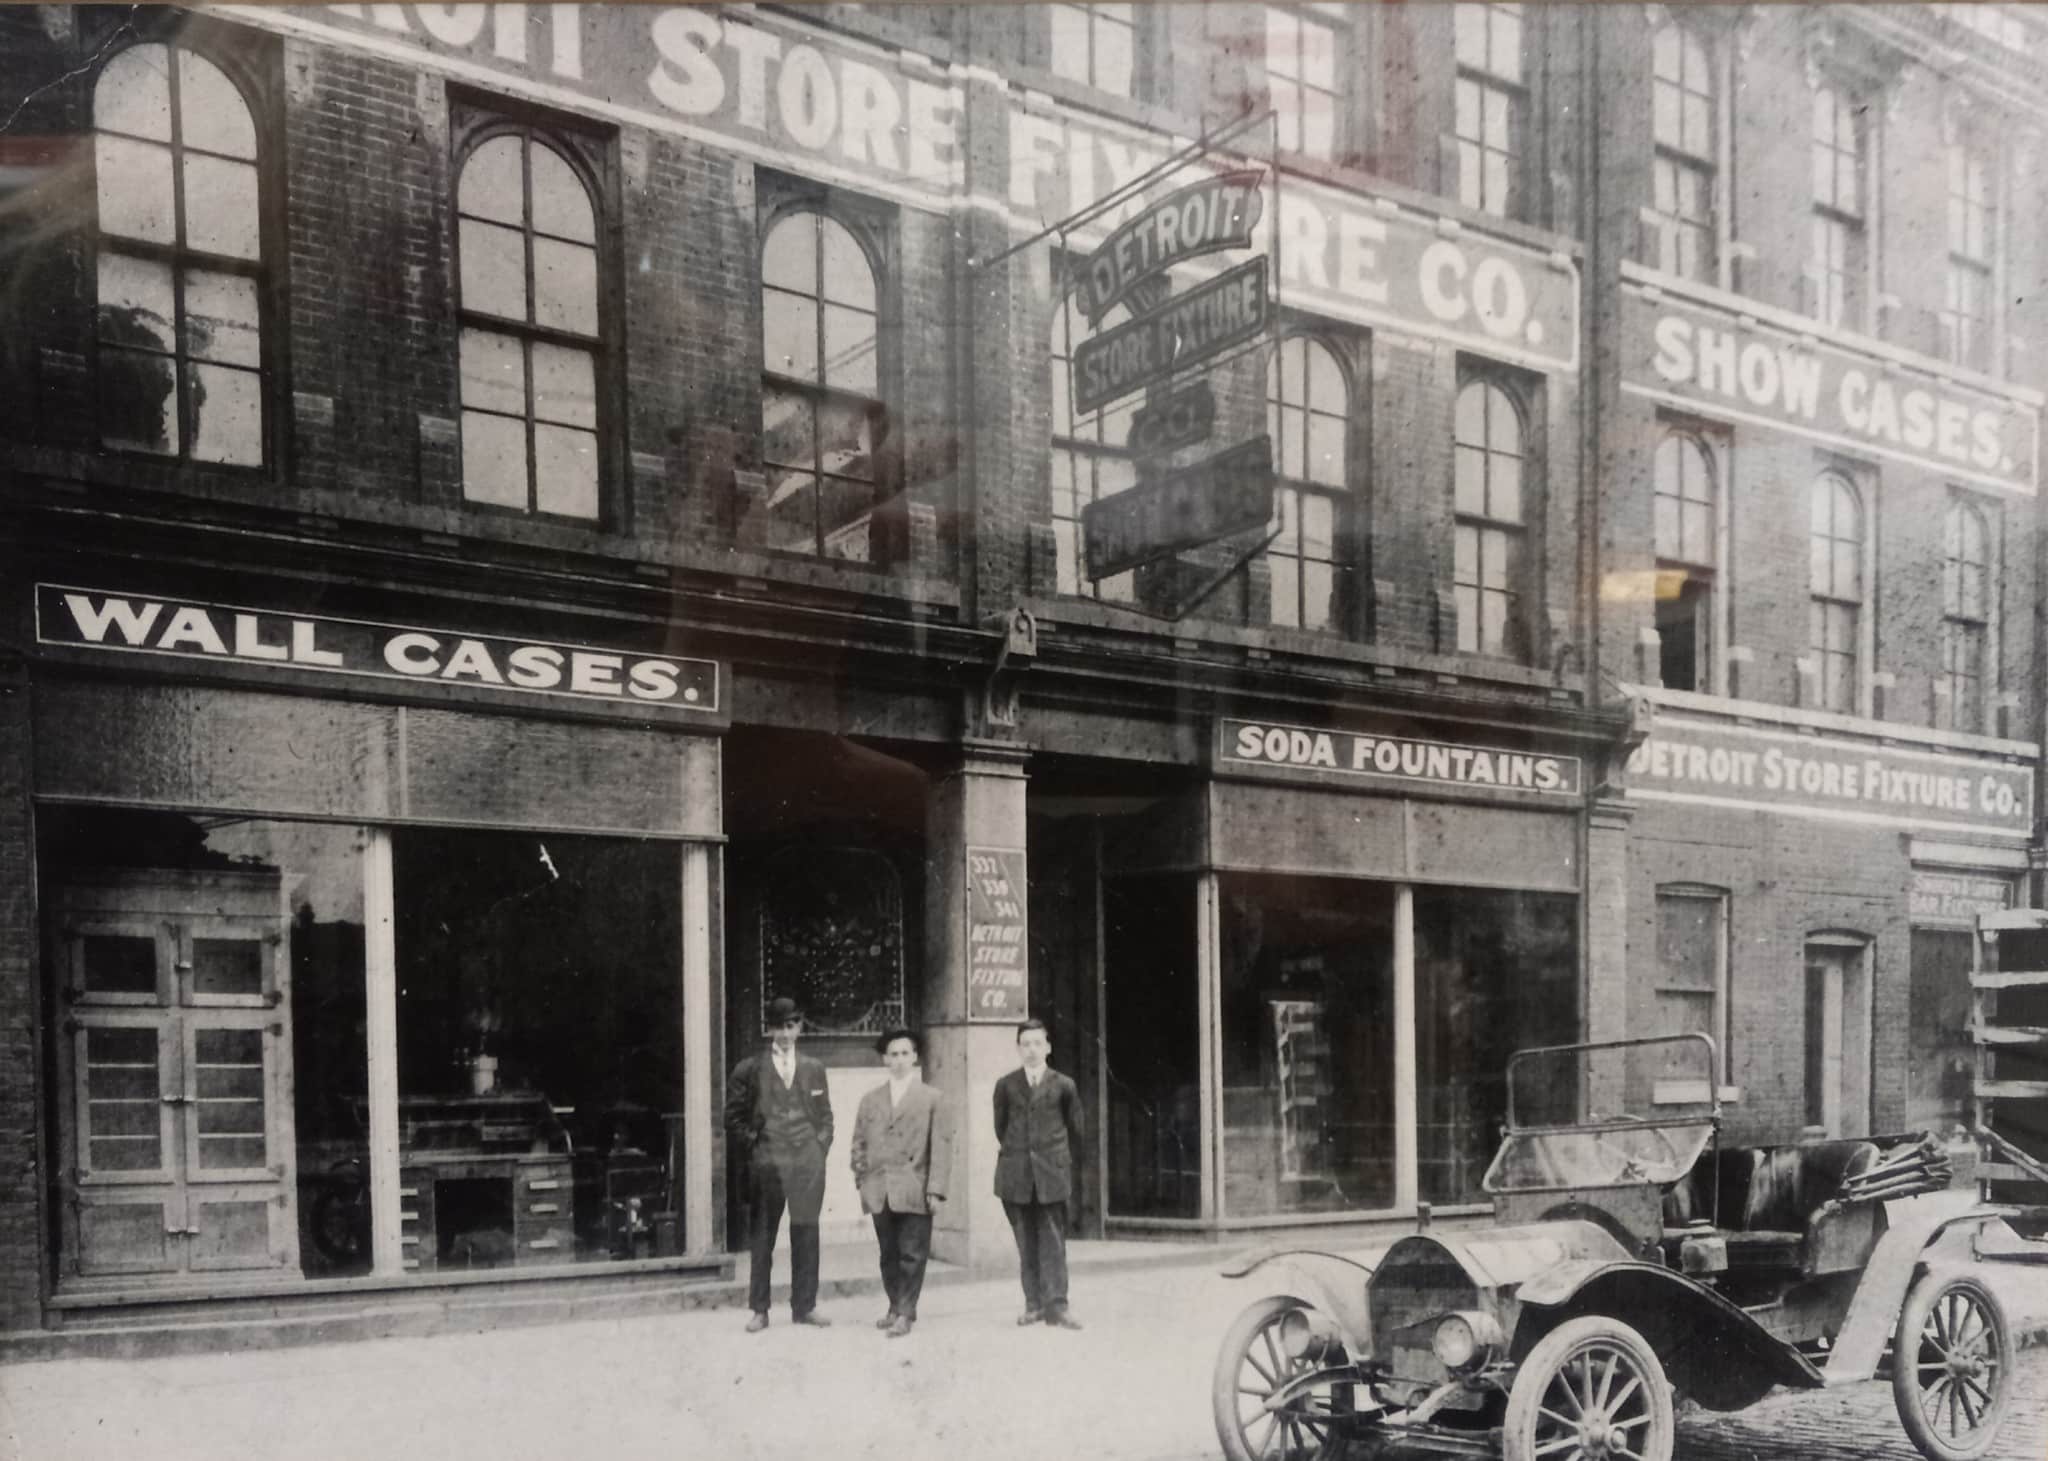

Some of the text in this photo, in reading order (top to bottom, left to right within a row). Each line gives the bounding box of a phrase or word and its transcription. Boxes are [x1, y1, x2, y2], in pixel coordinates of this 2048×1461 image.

[648, 8, 965, 185] STORE
[1008, 108, 1388, 301] FIXRE
[1419, 240, 1544, 342] CO.
[1092, 186, 1247, 304] DETROIT
[1084, 271, 1258, 399] STORE FIXTURE
[1654, 316, 2013, 472] SHOW CASES.
[63, 593, 699, 701] WALL CASES.
[1236, 725, 1569, 790] SODA FOUNTAINS.
[1762, 747, 1858, 798] STORE
[1862, 759, 1971, 810] FIXTURE
[970, 923, 1024, 943] DETROIT
[973, 945, 1020, 964] STORE
[970, 967, 1025, 986] FIXTURE
